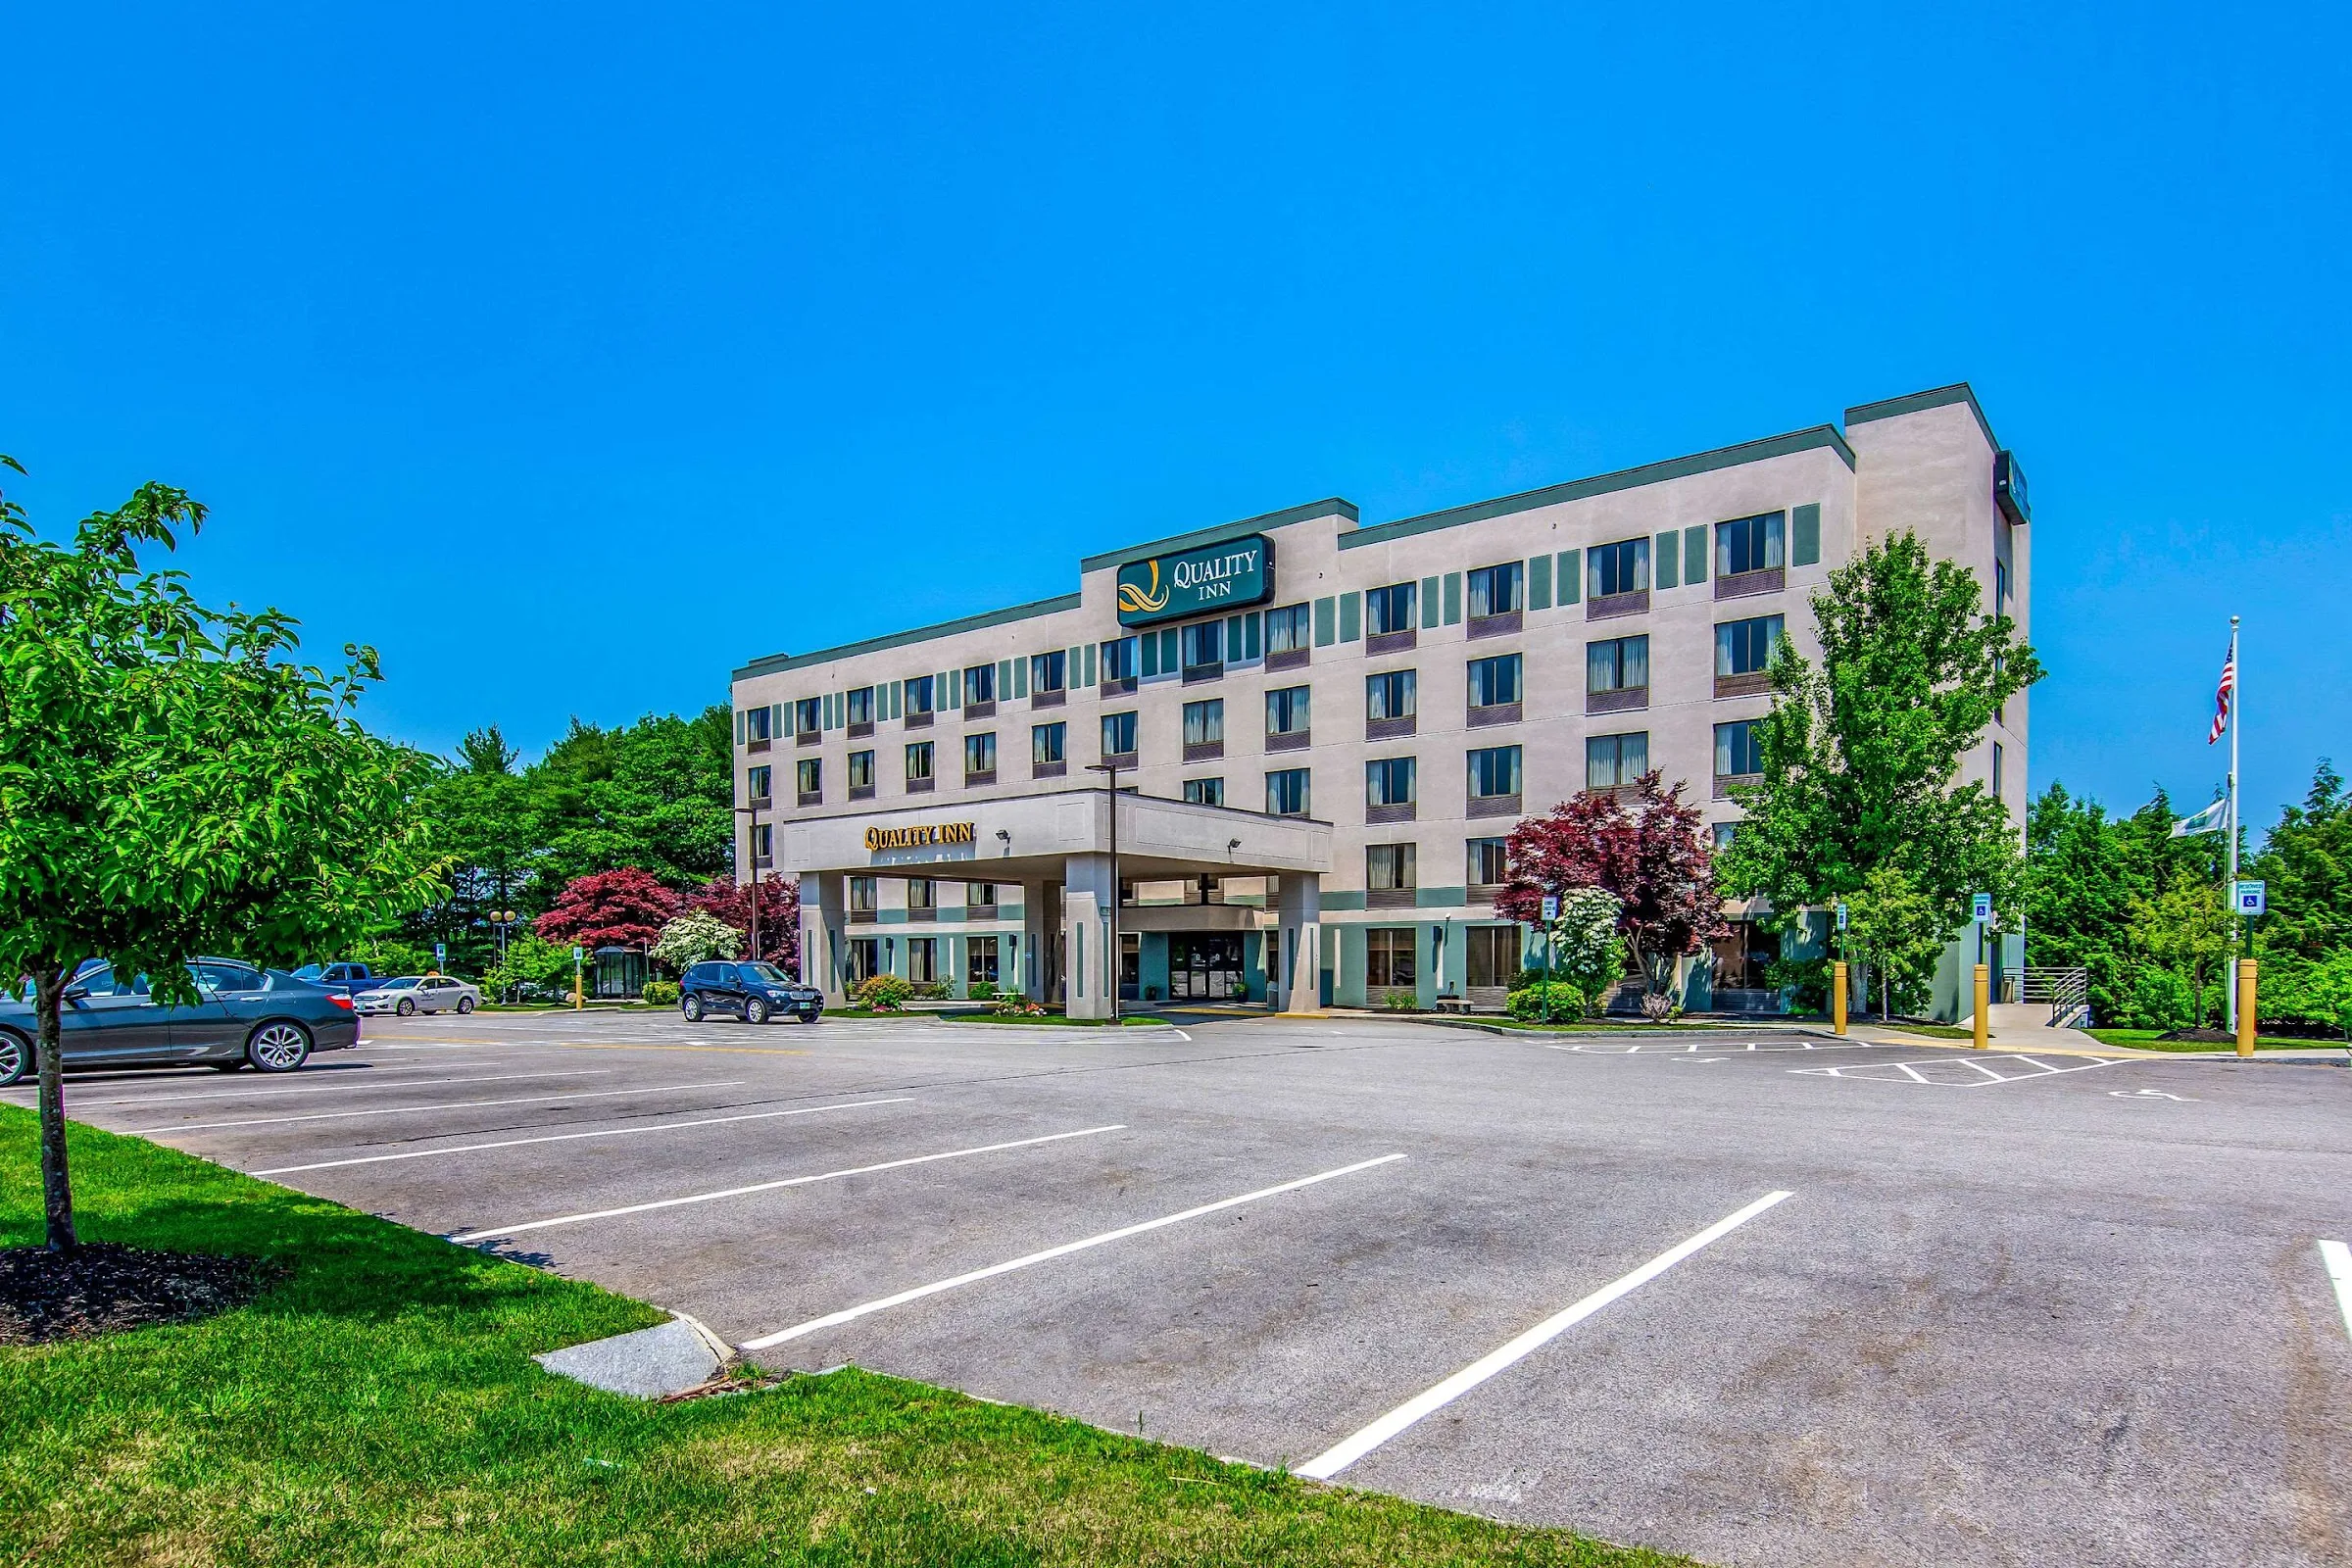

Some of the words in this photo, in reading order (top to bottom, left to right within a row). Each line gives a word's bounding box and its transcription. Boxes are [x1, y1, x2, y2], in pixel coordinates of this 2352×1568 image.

[1174, 550, 1257, 589] QUALITY
[1199, 580, 1232, 601] INN
[864, 826, 935, 851] QUALITY
[938, 822, 974, 844] INN
